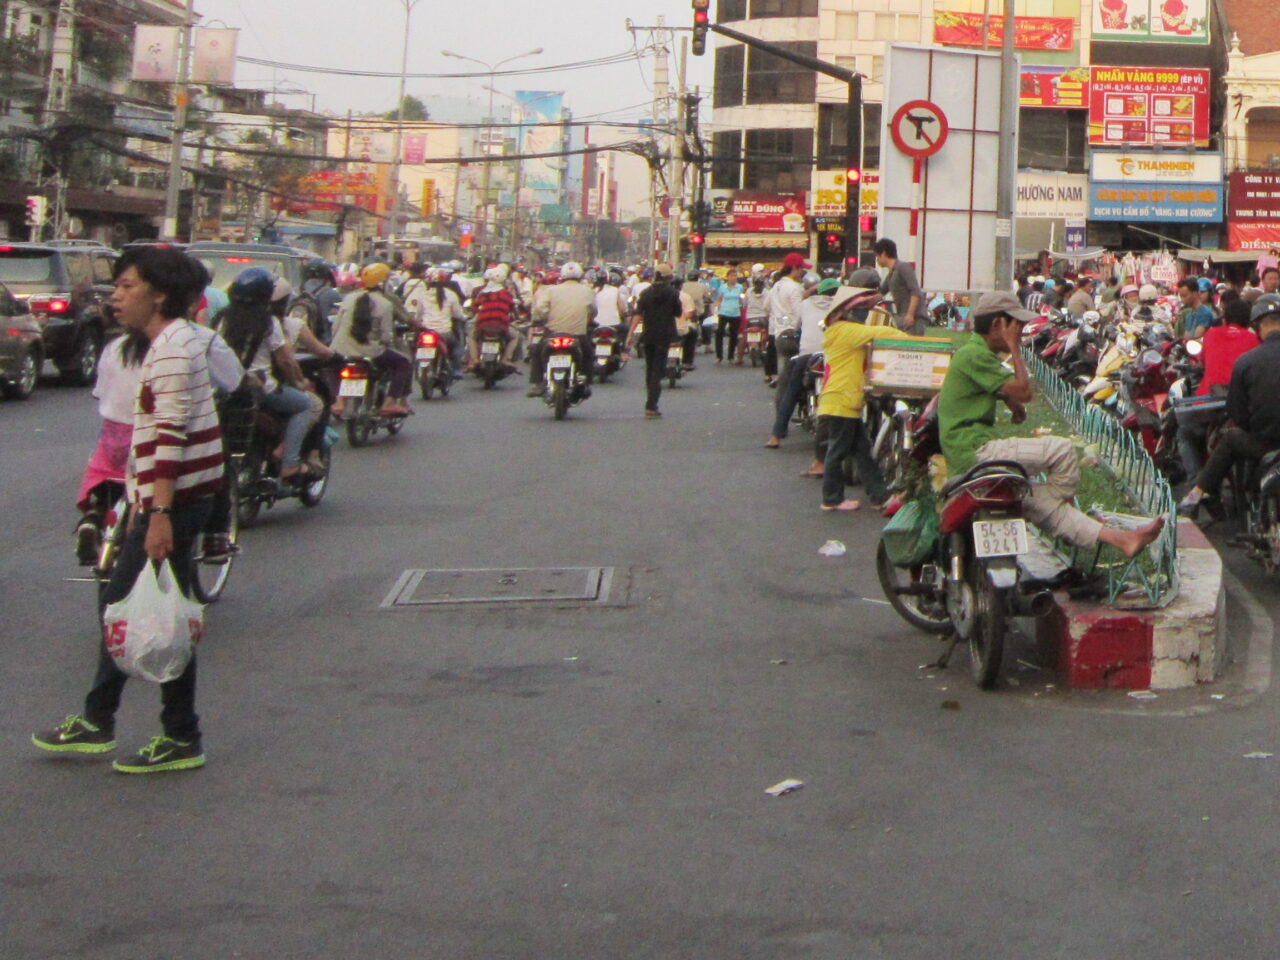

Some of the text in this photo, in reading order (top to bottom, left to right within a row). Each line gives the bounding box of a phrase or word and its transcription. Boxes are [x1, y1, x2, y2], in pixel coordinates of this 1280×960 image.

[1156, 72, 1179, 83] 9999
[1137, 161, 1195, 171] THANHNIEN
[1264, 176, 1273, 184] TY
[1017, 184, 1082, 201] HƯƠNG NAM
[733, 205, 753, 213] MAI
[756, 202, 785, 213] DŨNG
[981, 521, 1018, 537] 54-S6
[983, 538, 1018, 553] 9241
